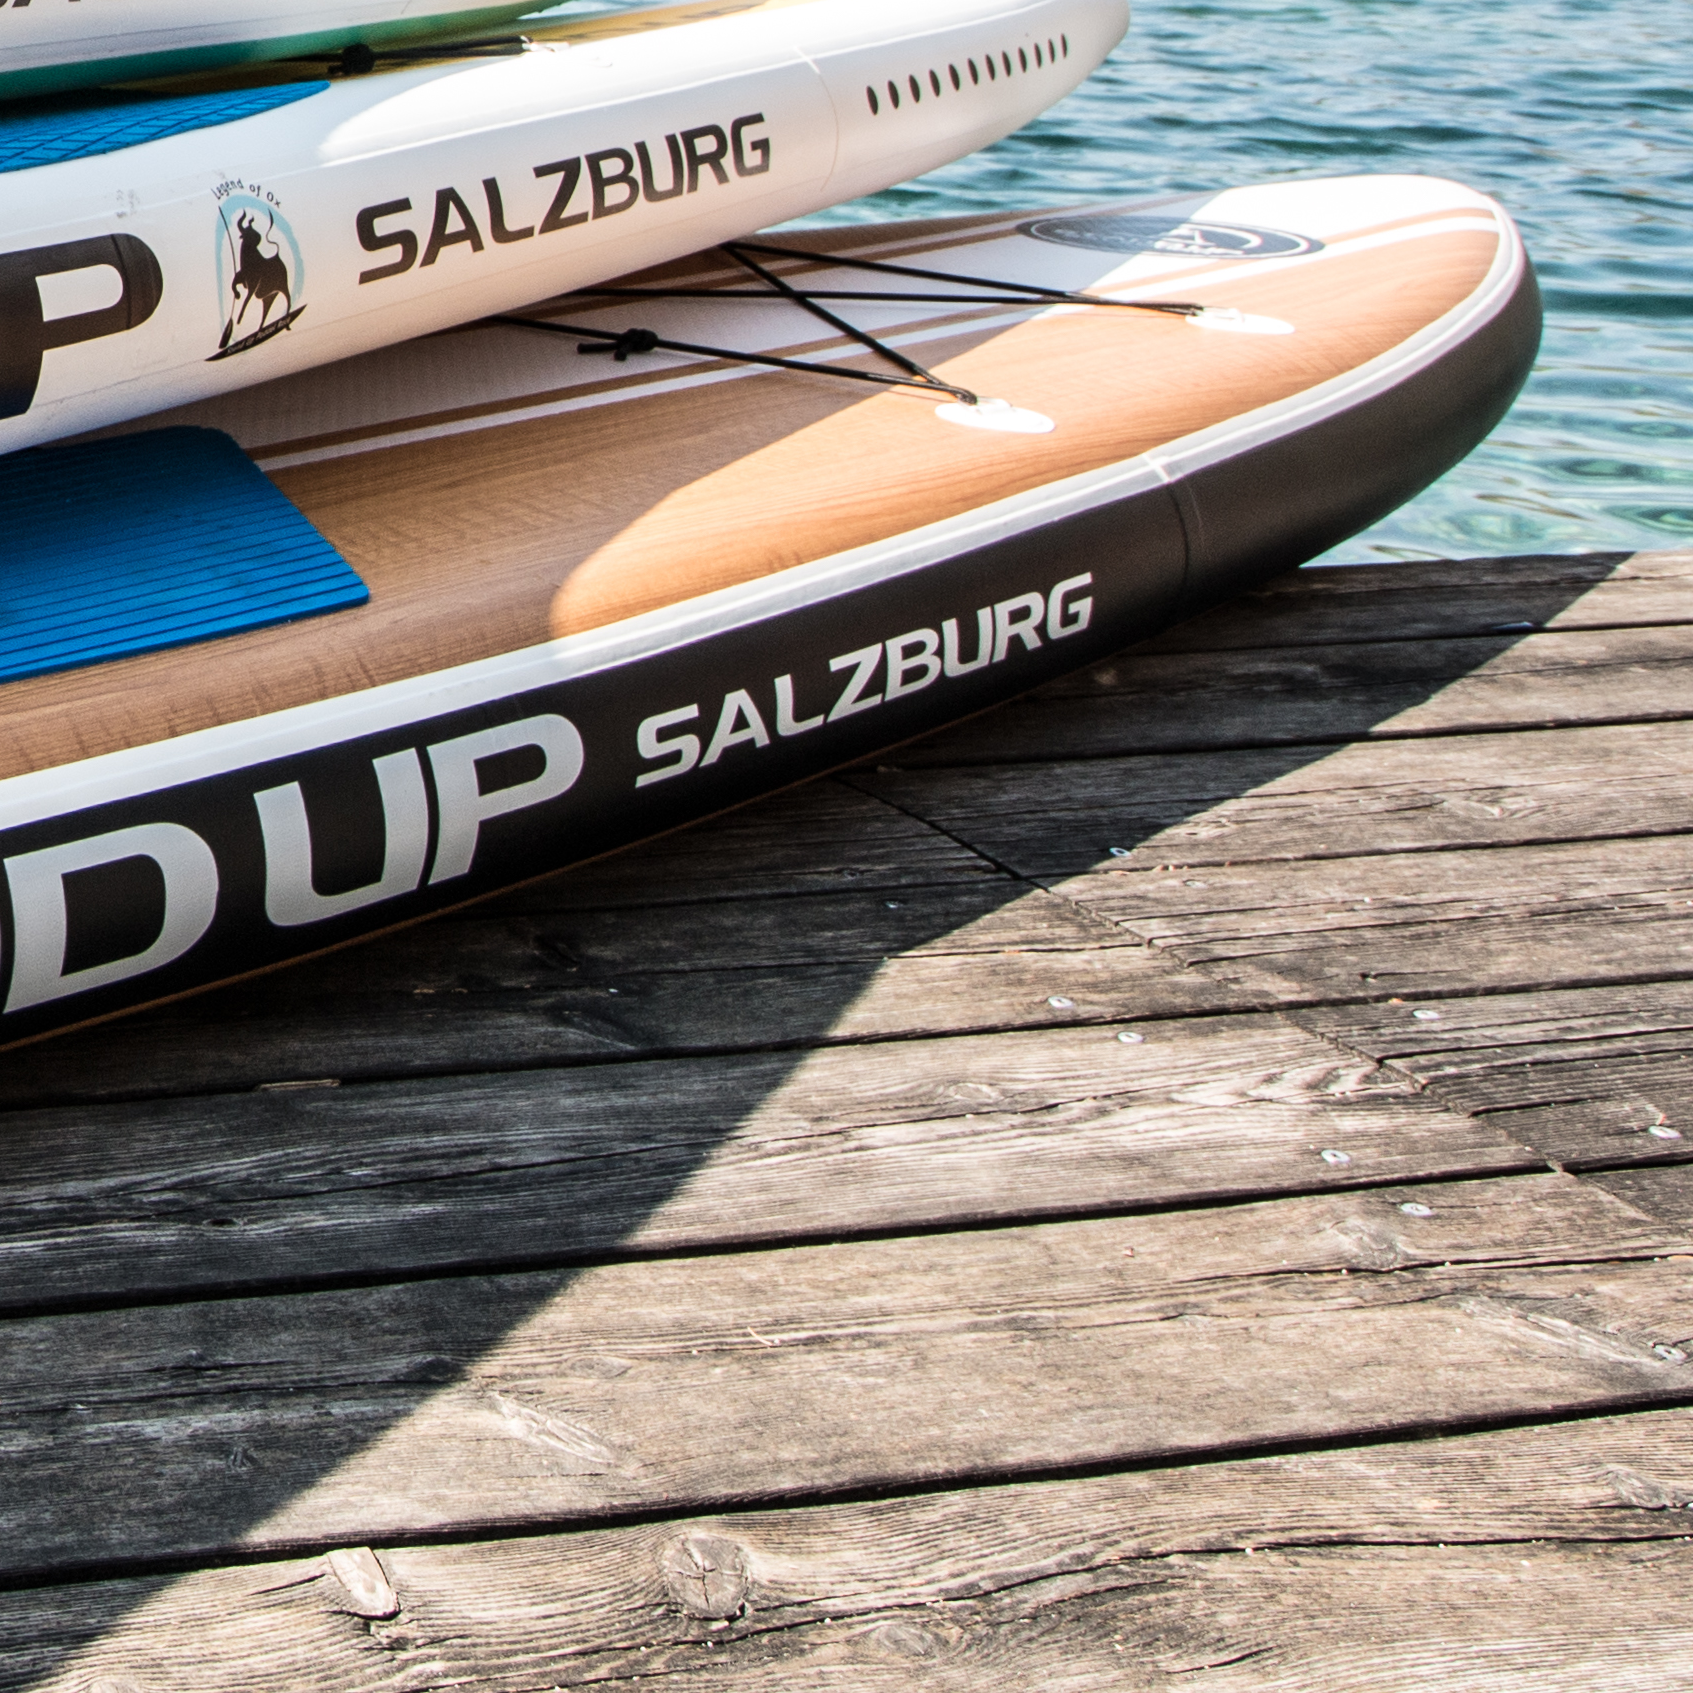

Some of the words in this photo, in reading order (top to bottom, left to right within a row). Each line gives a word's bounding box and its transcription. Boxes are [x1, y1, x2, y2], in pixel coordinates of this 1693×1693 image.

[210, 178, 244, 200] Legend
[249, 184, 261, 197] of
[266, 191, 281, 209] Ox
[356, 113, 769, 284] SALZBURG
[636, 570, 1097, 788] SALZBURG
